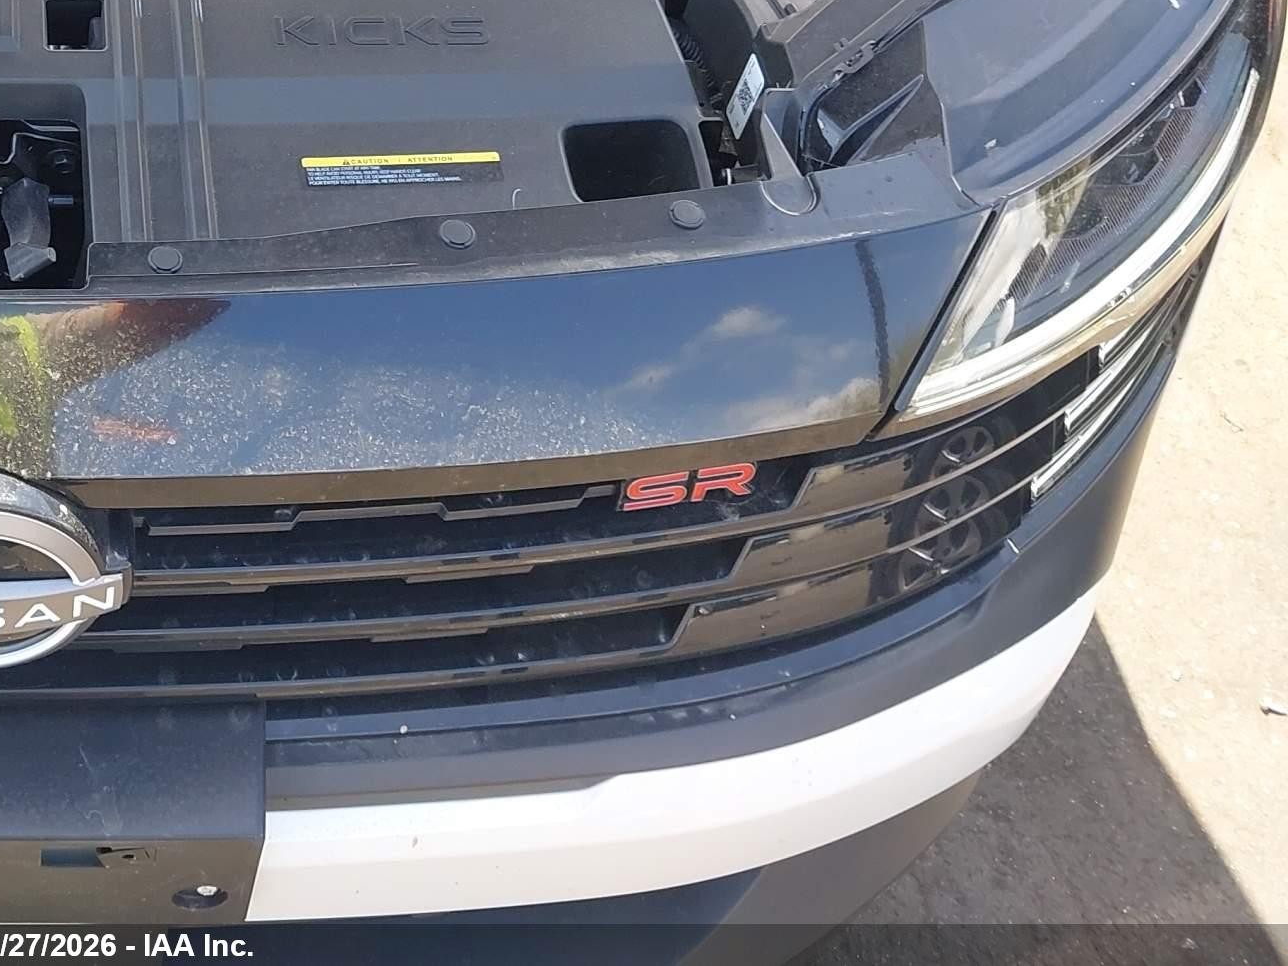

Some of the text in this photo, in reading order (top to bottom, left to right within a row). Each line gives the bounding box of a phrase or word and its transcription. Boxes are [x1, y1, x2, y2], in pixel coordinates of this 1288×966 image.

[273, 14, 491, 47] KICKS
[350, 155, 454, 166] CAUTION ATTENTION
[623, 462, 757, 512] SR
